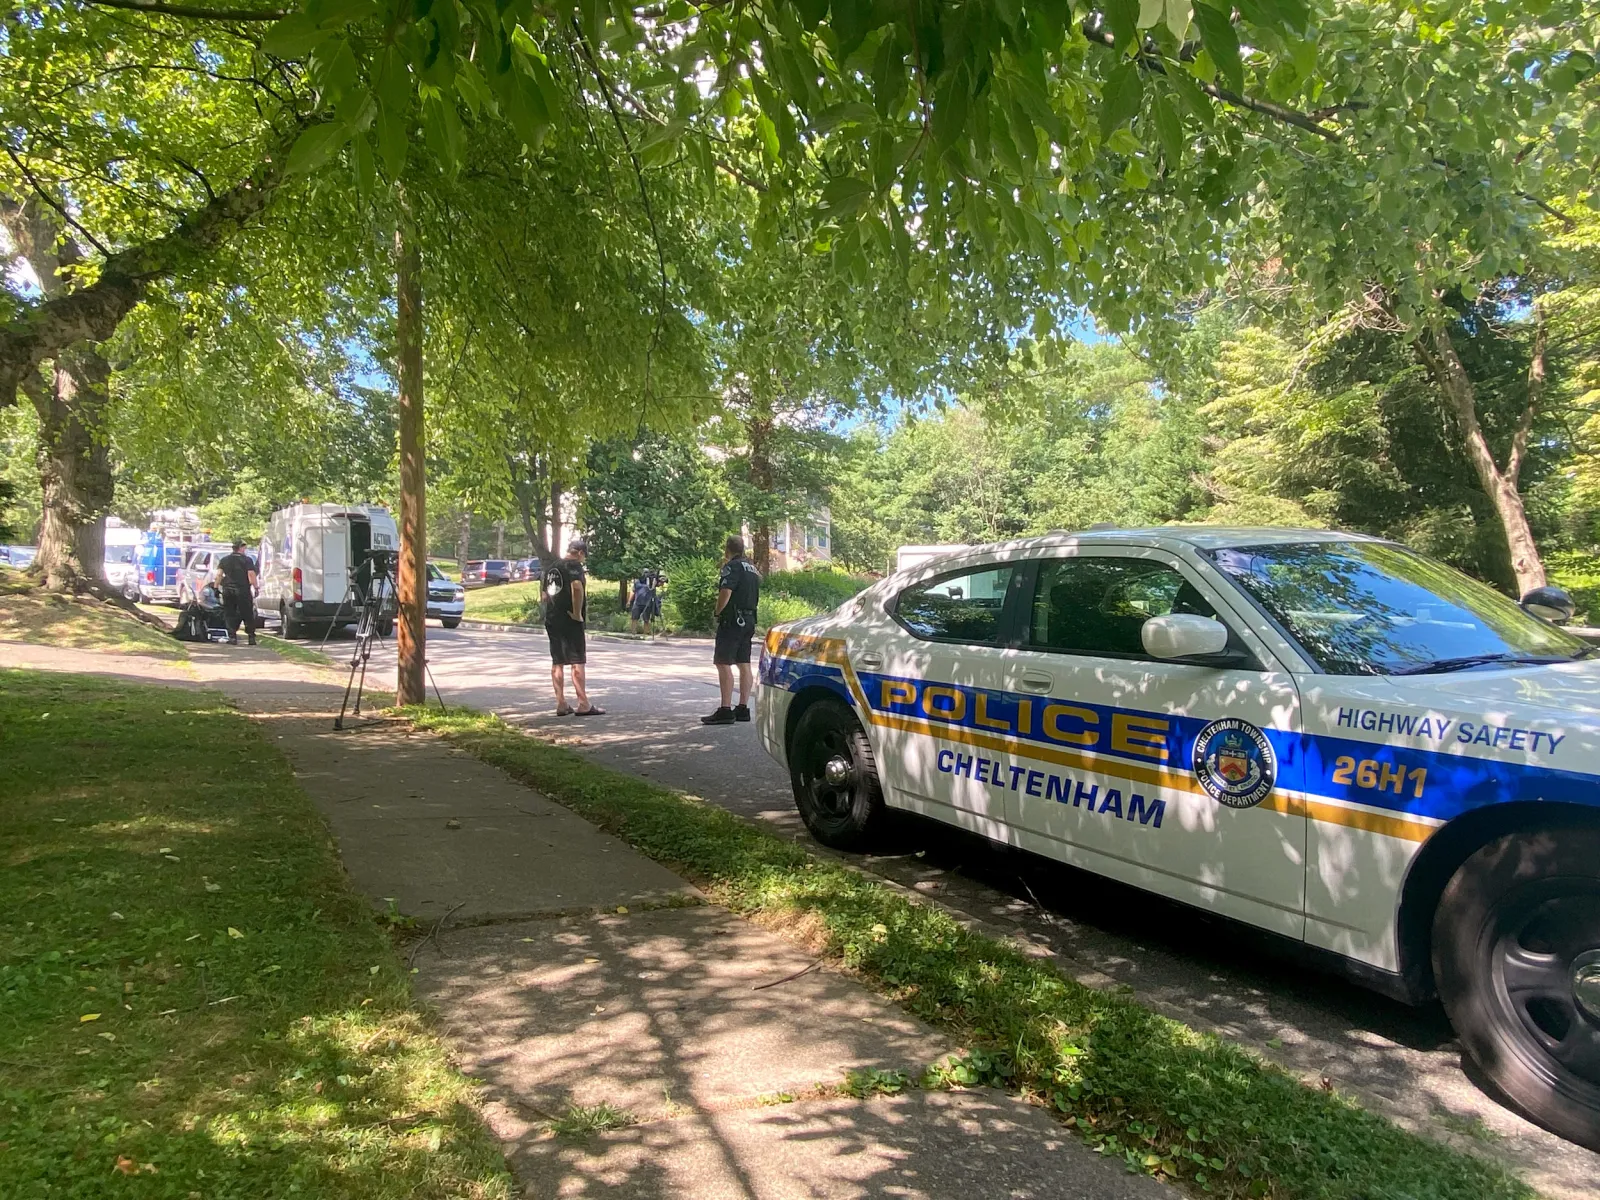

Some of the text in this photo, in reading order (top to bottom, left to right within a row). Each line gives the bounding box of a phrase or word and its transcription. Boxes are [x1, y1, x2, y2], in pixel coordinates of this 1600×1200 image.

[880, 680, 1170, 760] POLICE
[1197, 720, 1272, 764] CHELTENHAM TOWNSHIP
[1337, 707, 1566, 755] HIGHWAY SAFETY
[937, 750, 1167, 828] CHELTENHAM
[1198, 769, 1221, 798] POLICE
[1221, 780, 1270, 806] DEPARTMENT
[1332, 755, 1427, 798] 26H1
